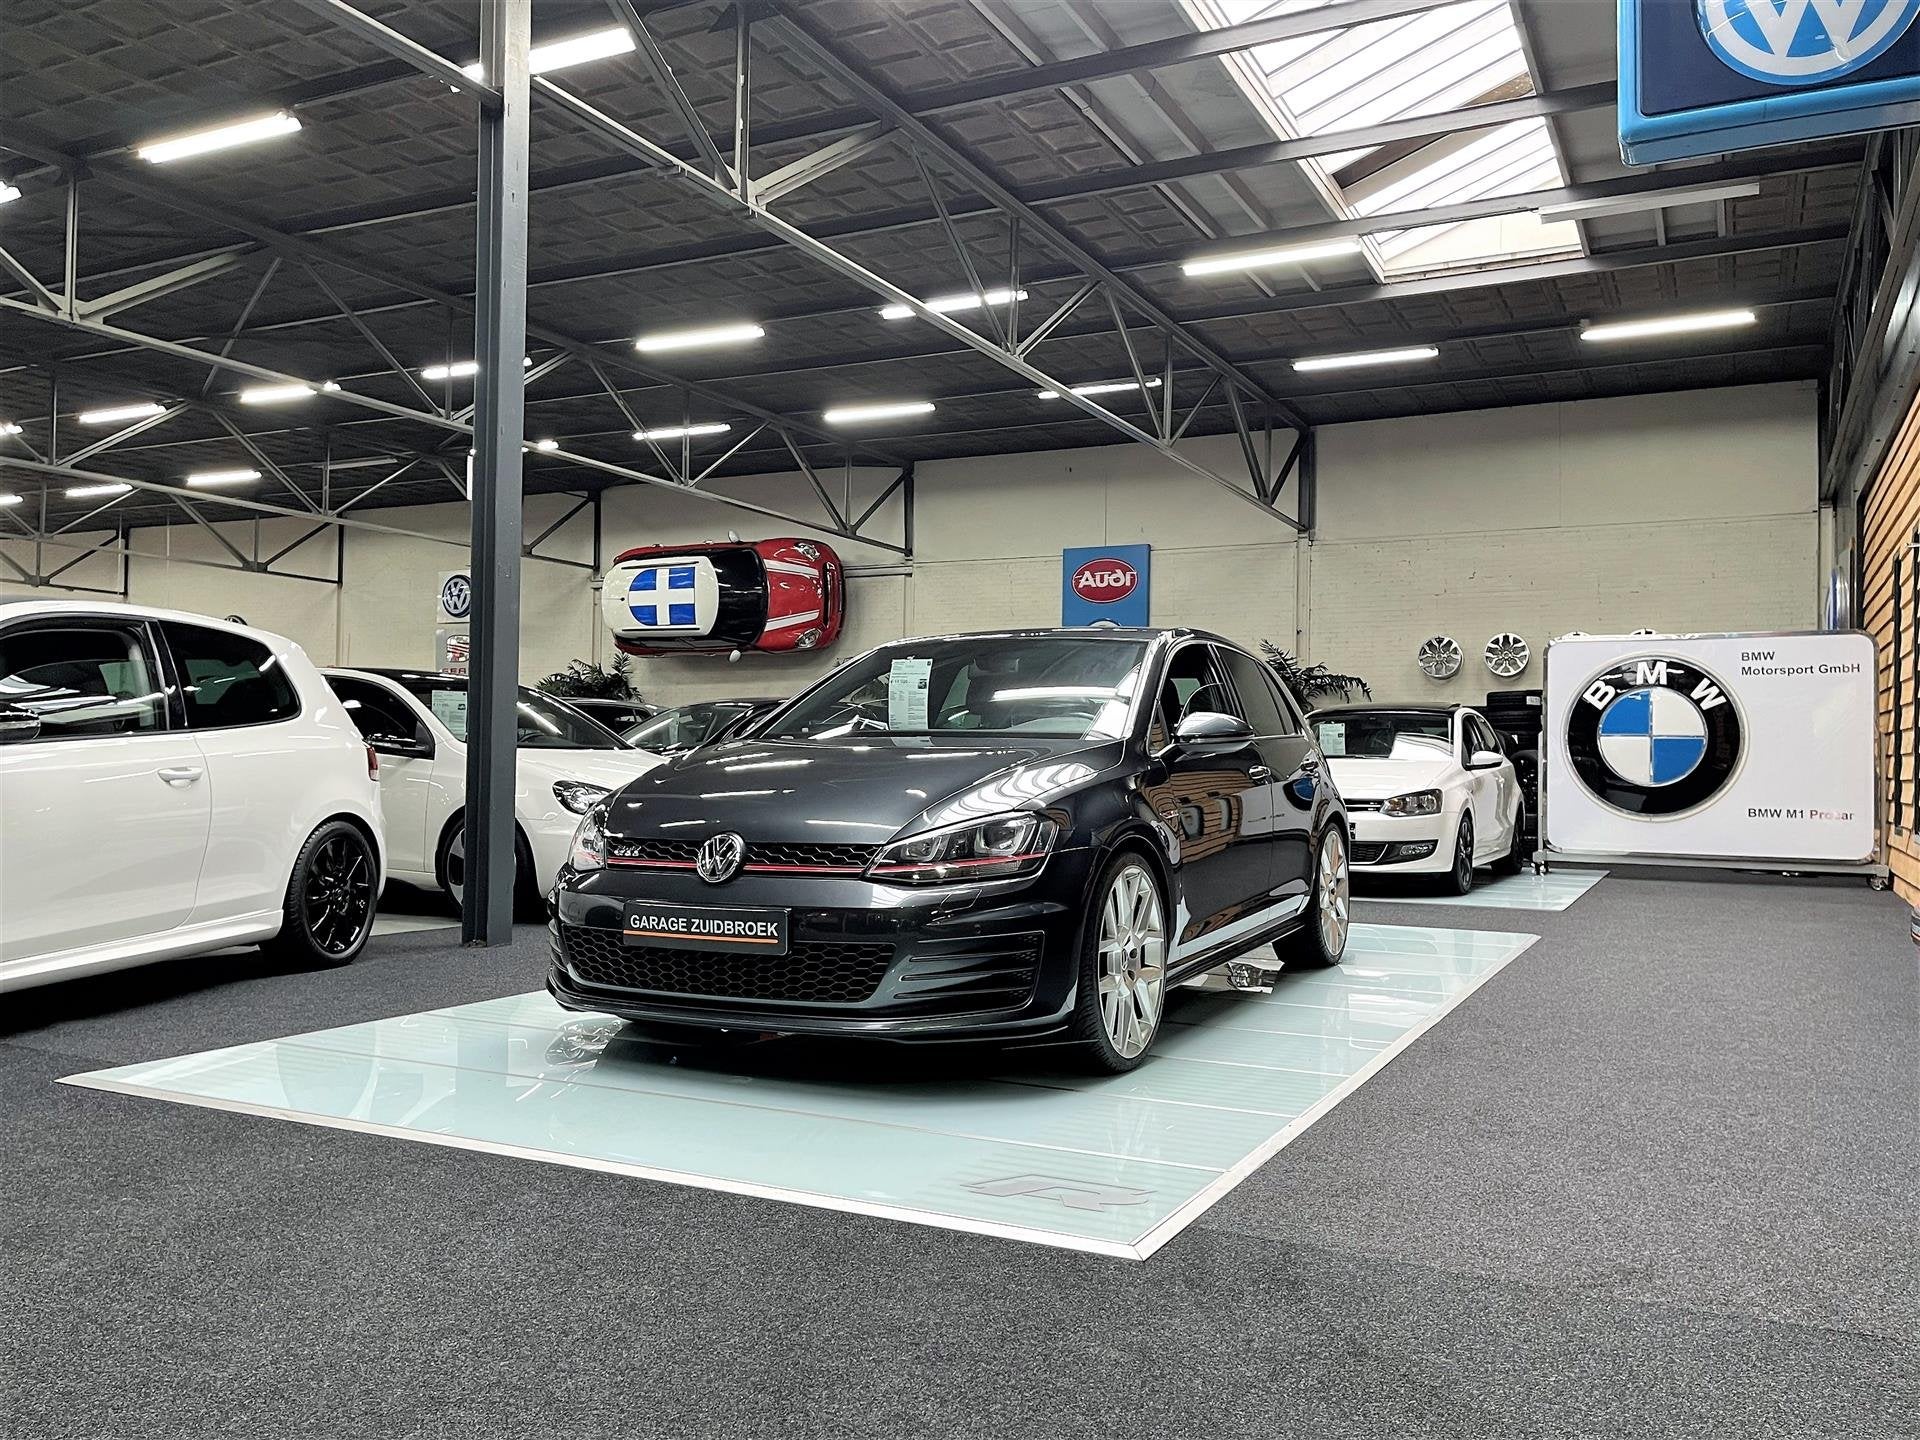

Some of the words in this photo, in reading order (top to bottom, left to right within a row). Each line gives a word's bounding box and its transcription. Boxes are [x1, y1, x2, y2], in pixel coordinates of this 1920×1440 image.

[1741, 651, 1775, 662] BMW
[1741, 665, 1814, 676] Motorsport
[1818, 663, 1860, 674] GmbH
[1582, 661, 1727, 711] BMW
[1748, 808, 1782, 819] BMW
[1786, 809, 1804, 819] M1
[1809, 809, 1854, 821] Proar
[630, 914, 688, 932] GARAGE
[690, 918, 779, 937] ZUIDBROEK
